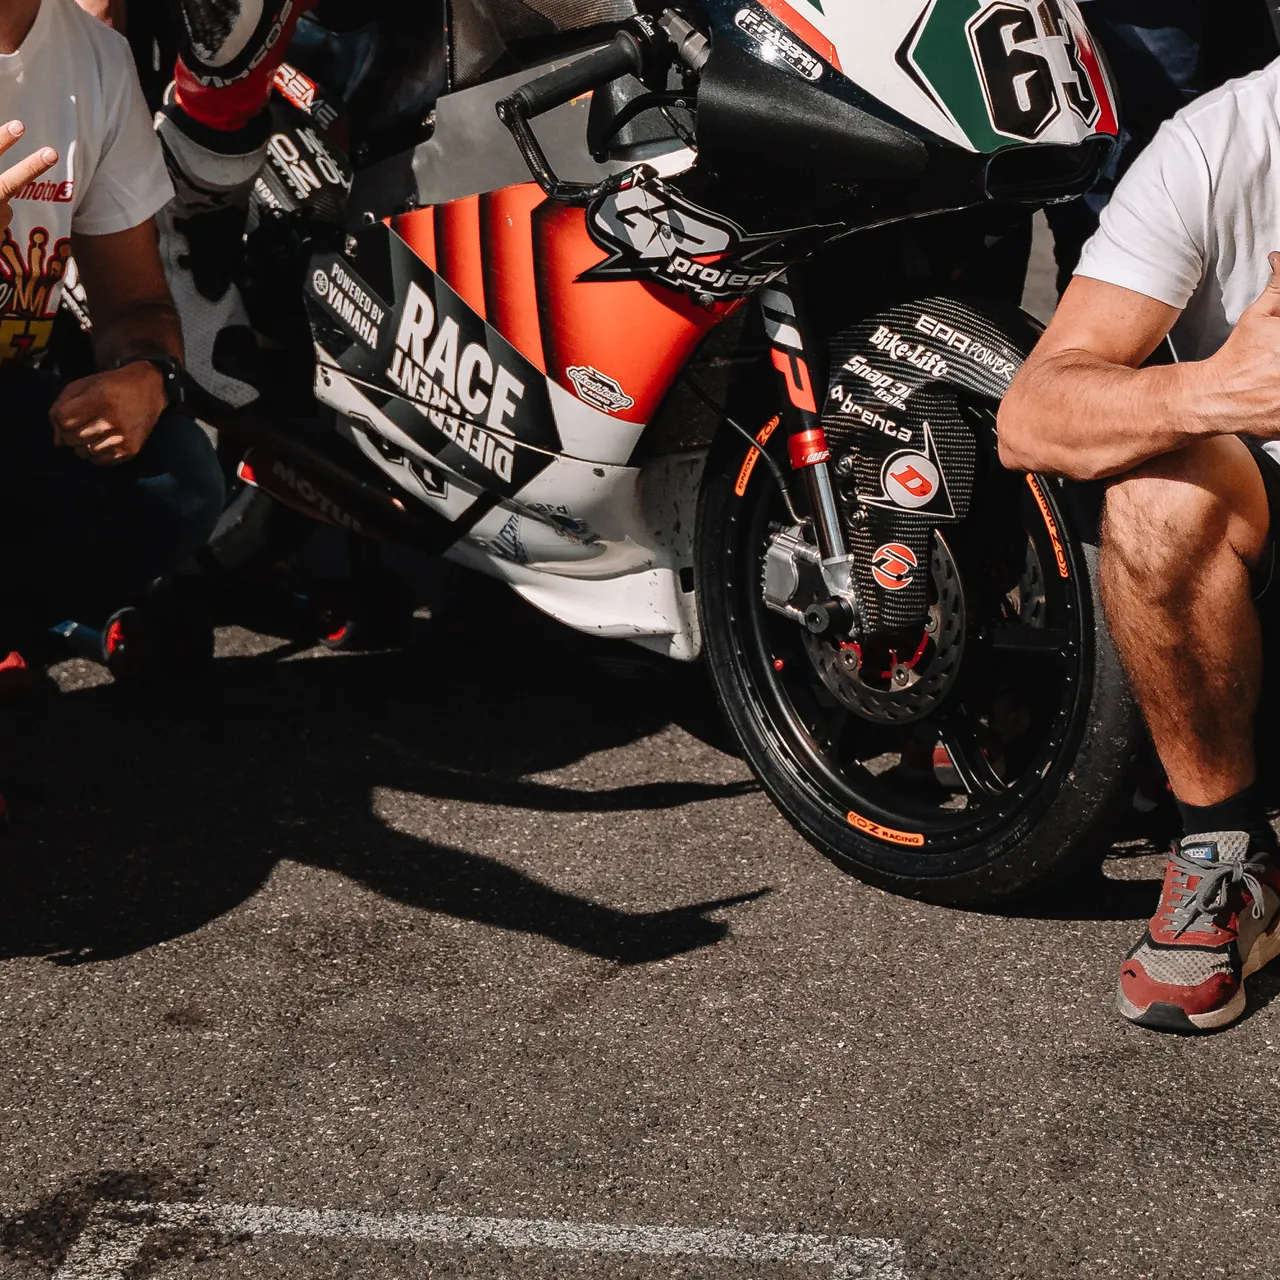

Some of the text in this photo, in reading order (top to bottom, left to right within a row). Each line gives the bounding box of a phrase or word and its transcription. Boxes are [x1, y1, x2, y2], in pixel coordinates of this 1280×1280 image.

[326, 283, 379, 350] YAMAHA
[332, 262, 385, 325] POWERED BY
[395, 280, 526, 437] RACE
[868, 325, 948, 377] Bike-Lift
[840, 393, 913, 443] brenta
[737, 447, 757, 491] RACING
[857, 817, 920, 845] OZ RACING
